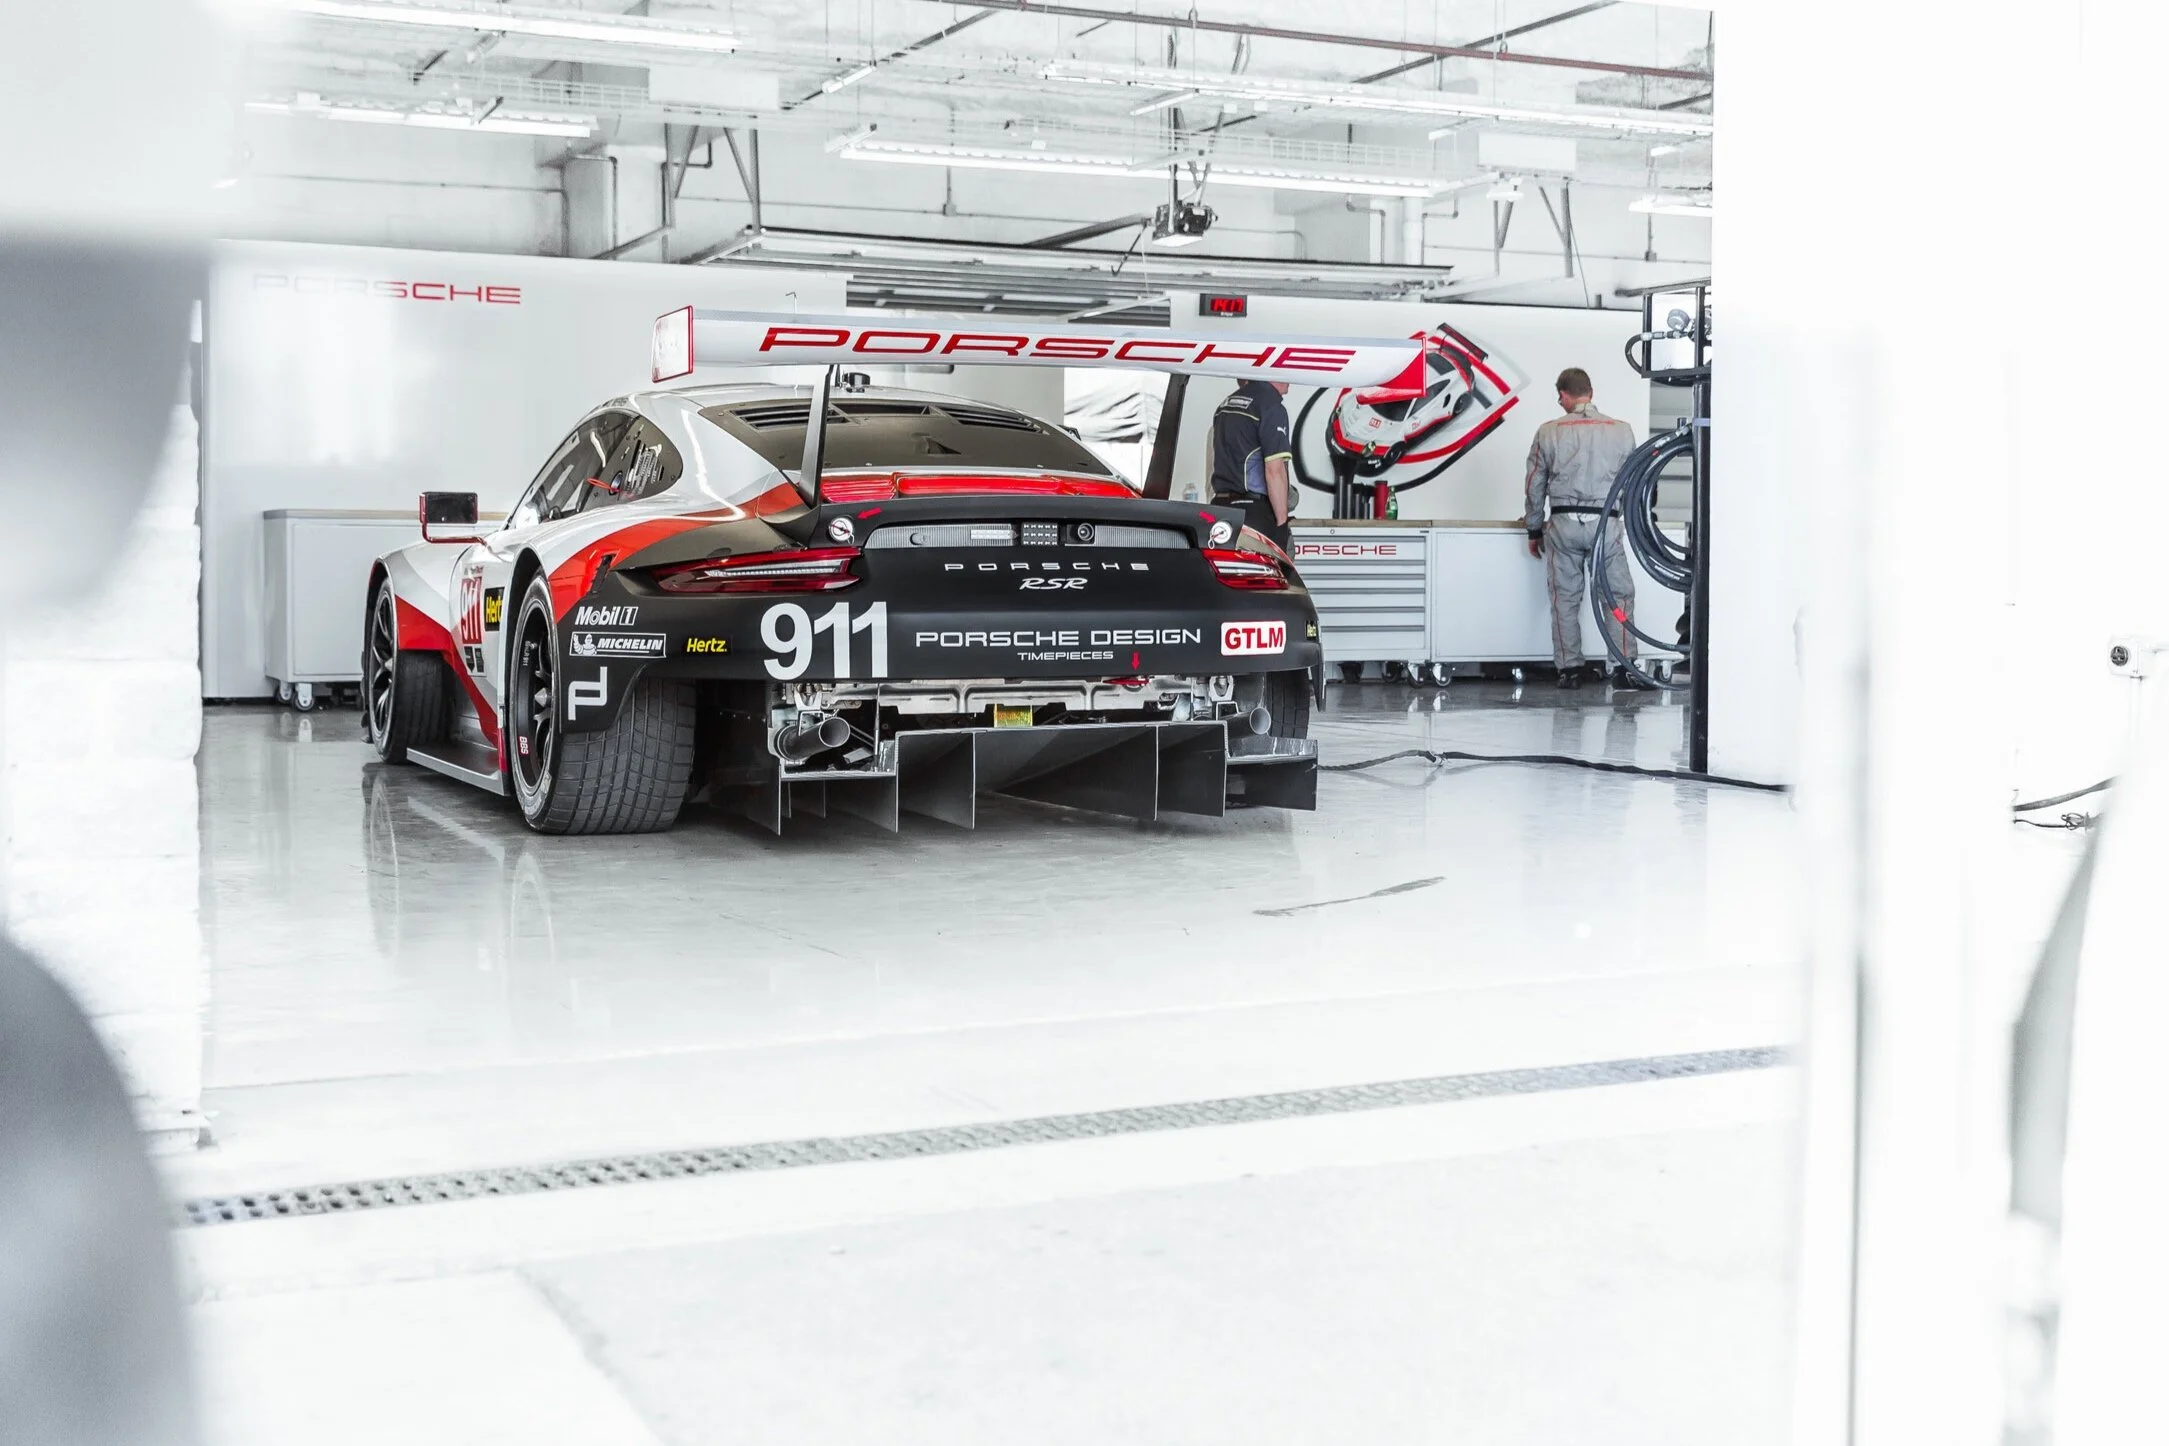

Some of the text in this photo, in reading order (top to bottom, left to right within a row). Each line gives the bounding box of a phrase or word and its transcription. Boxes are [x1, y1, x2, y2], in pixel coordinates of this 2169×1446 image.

[253, 274, 521, 305] PORSCHE
[759, 326, 1357, 372] PORSCHE
[1295, 545, 1397, 555] RSCHE
[945, 562, 1150, 571] PORSCHE
[1019, 577, 1088, 590] RSR
[461, 580, 480, 641] 911
[575, 606, 621, 626] Mobil
[597, 637, 664, 650] MICHELIN
[760, 601, 888, 680] 911
[915, 628, 1201, 648] PORSCHE DESIGN
[1224, 627, 1285, 651] GTLM
[1017, 650, 1114, 661] TIMEPIECES
[519, 736, 529, 755] BBS
